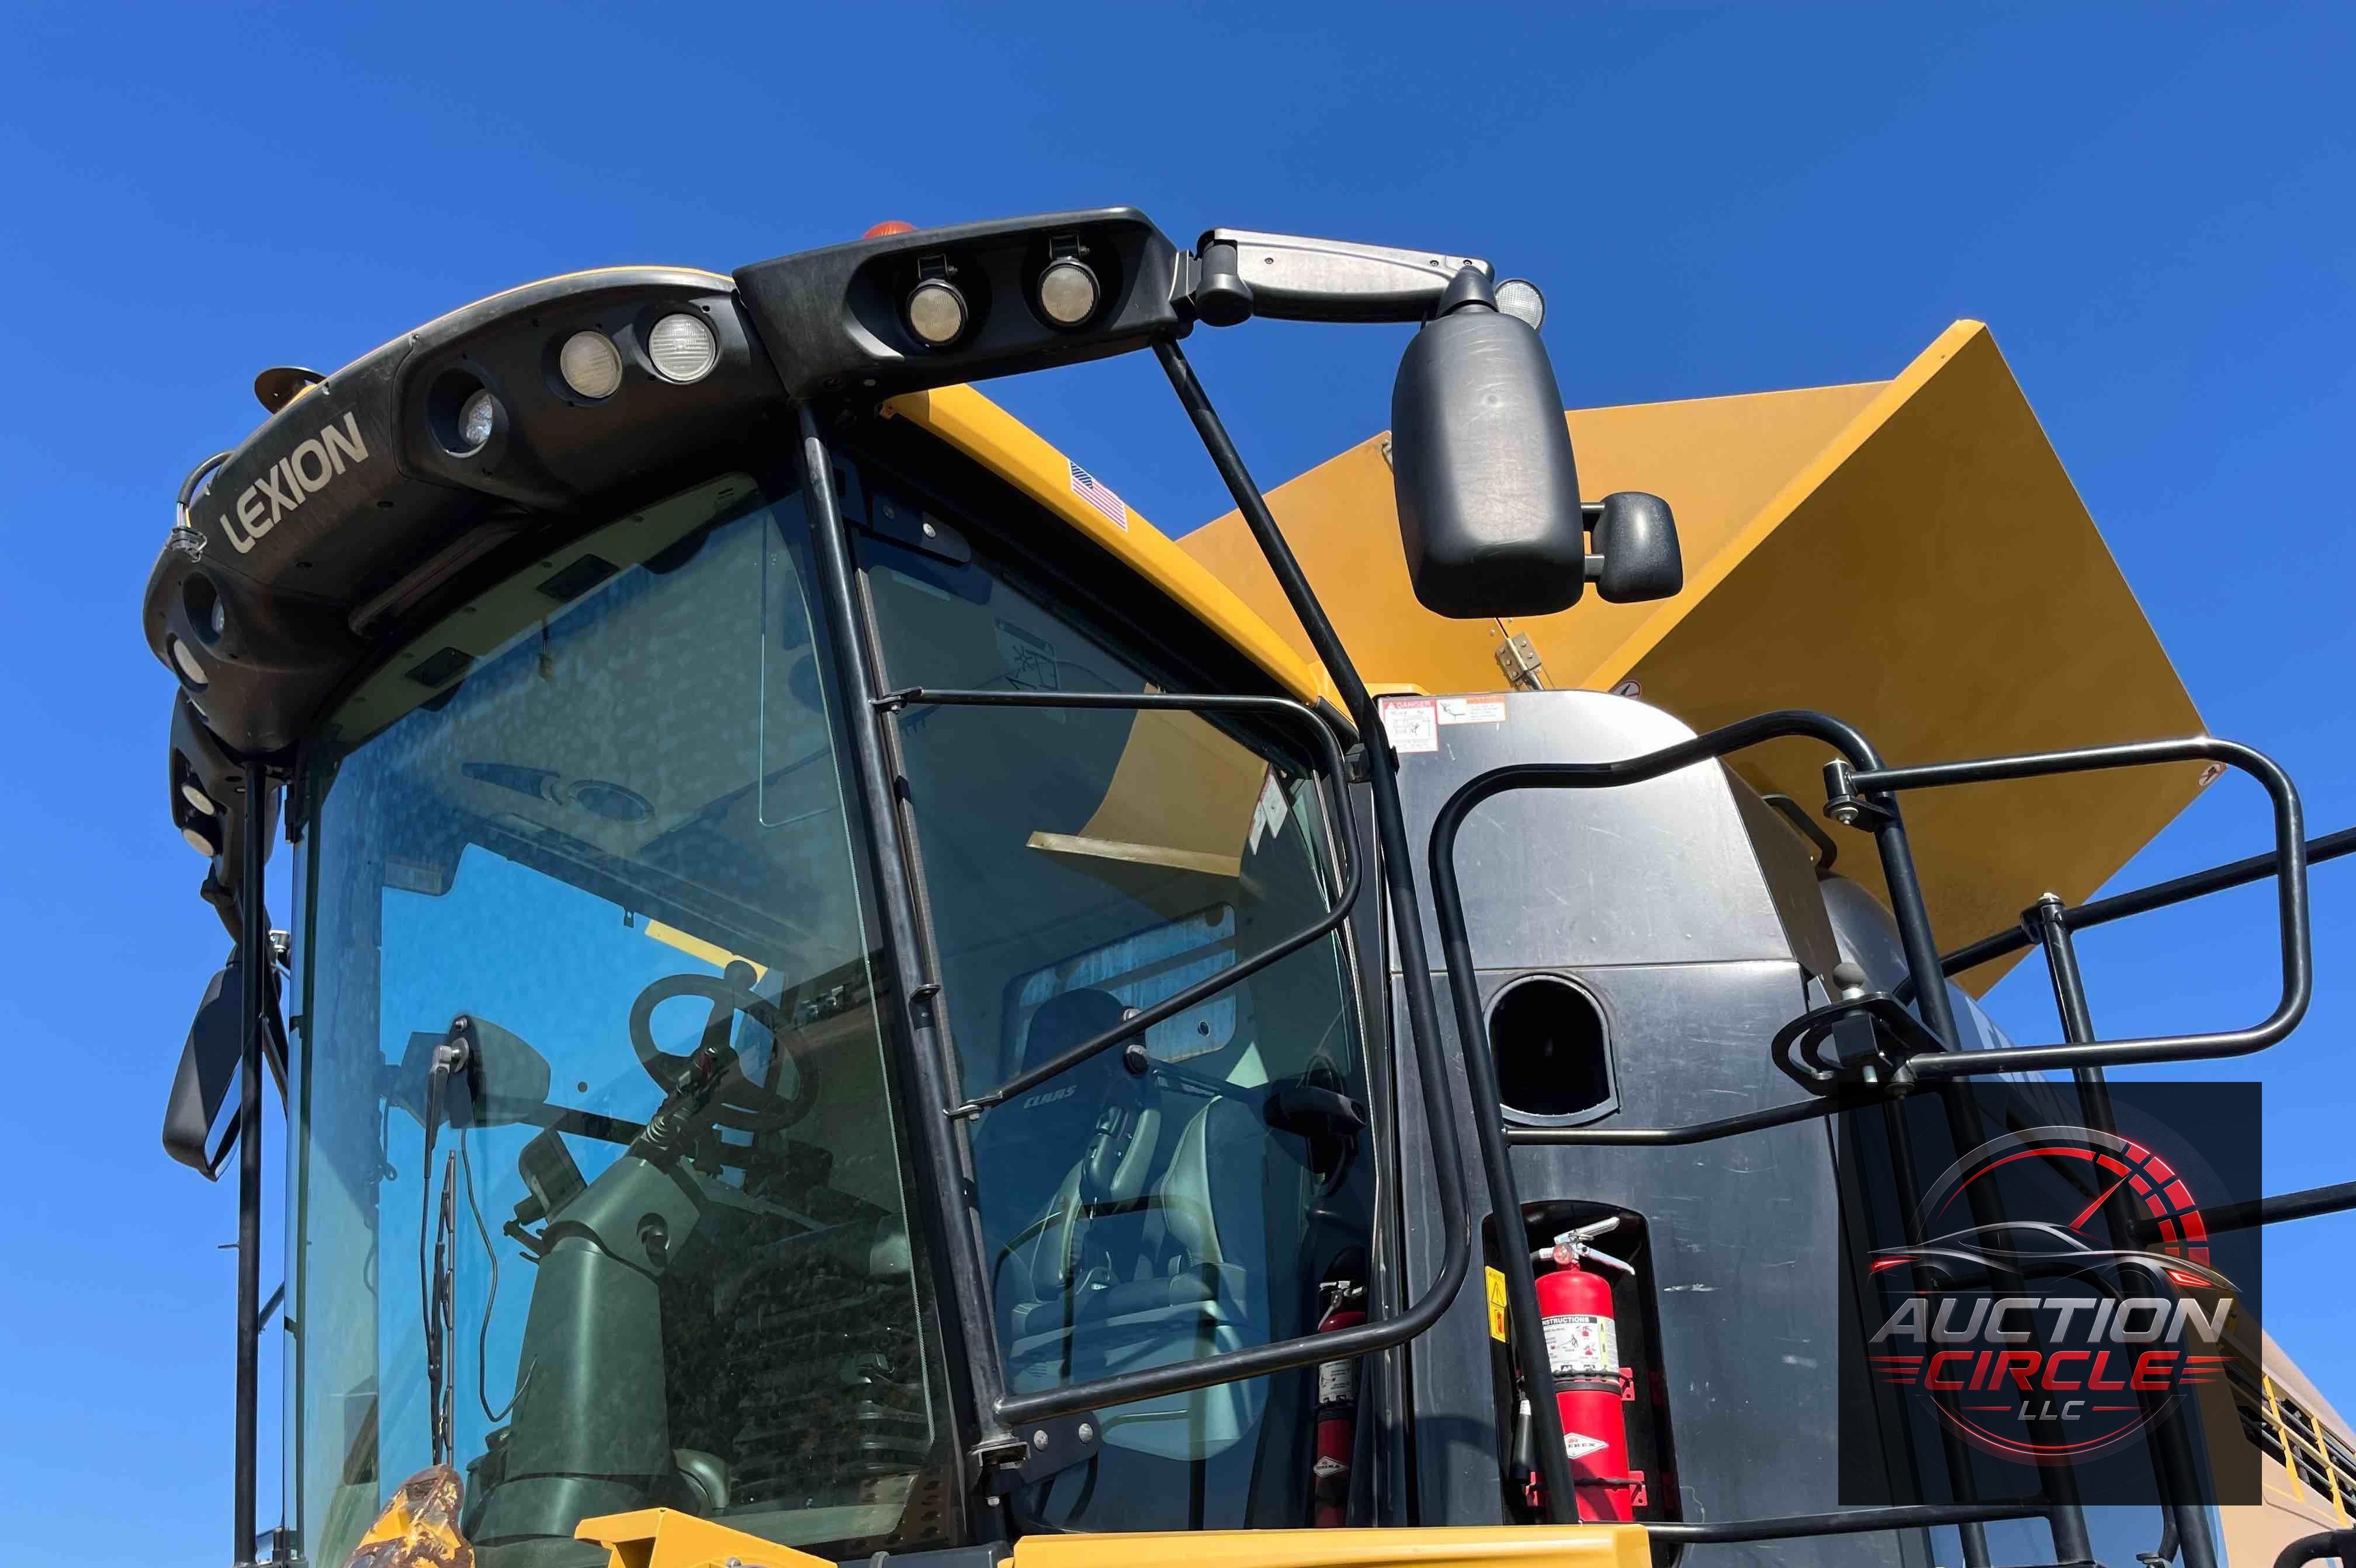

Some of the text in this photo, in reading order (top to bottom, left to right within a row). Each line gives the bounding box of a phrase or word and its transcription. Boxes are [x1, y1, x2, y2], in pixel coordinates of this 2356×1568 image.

[220, 411, 369, 554] LEXION
[1023, 1085, 1077, 1108] CLAAS
[1541, 1316, 1589, 1326] NSTRUCTIONS
